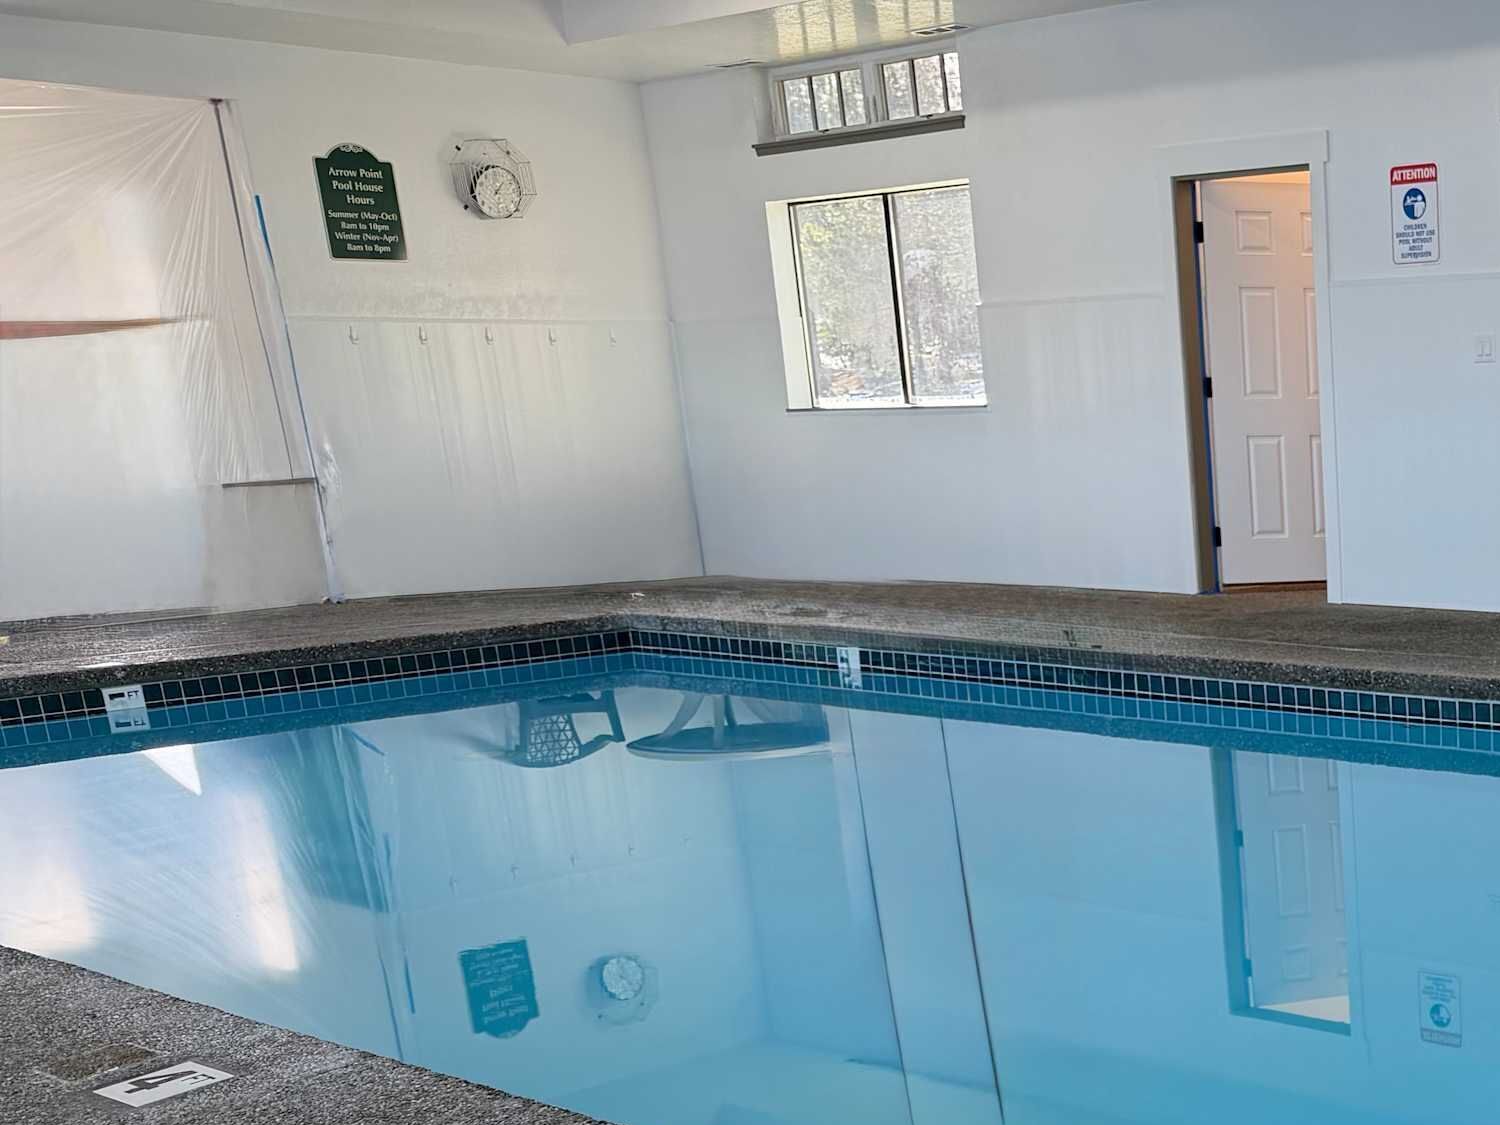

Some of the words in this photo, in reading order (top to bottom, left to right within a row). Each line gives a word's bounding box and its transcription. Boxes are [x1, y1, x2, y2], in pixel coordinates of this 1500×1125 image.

[328, 167, 357, 178] Arrow
[359, 168, 383, 179] Point
[1392, 168, 1436, 182] ATTENTION
[332, 180, 353, 190] Pool
[355, 182, 384, 193] House
[346, 194, 375, 205] Hours
[328, 209, 359, 220] Summer
[361, 210, 398, 222] (May-Oct)
[341, 221, 358, 230] 8am
[359, 222, 368, 230] to
[369, 222, 390, 234] 10pm
[335, 231, 361, 241] Winter
[363, 232, 399, 244] (Nov-Apr)
[347, 242, 363, 252] 8am
[364, 243, 373, 252] to
[374, 243, 391, 254] 8pm
[125, 1070, 198, 1094] 4
[182, 1073, 216, 1085] FT
